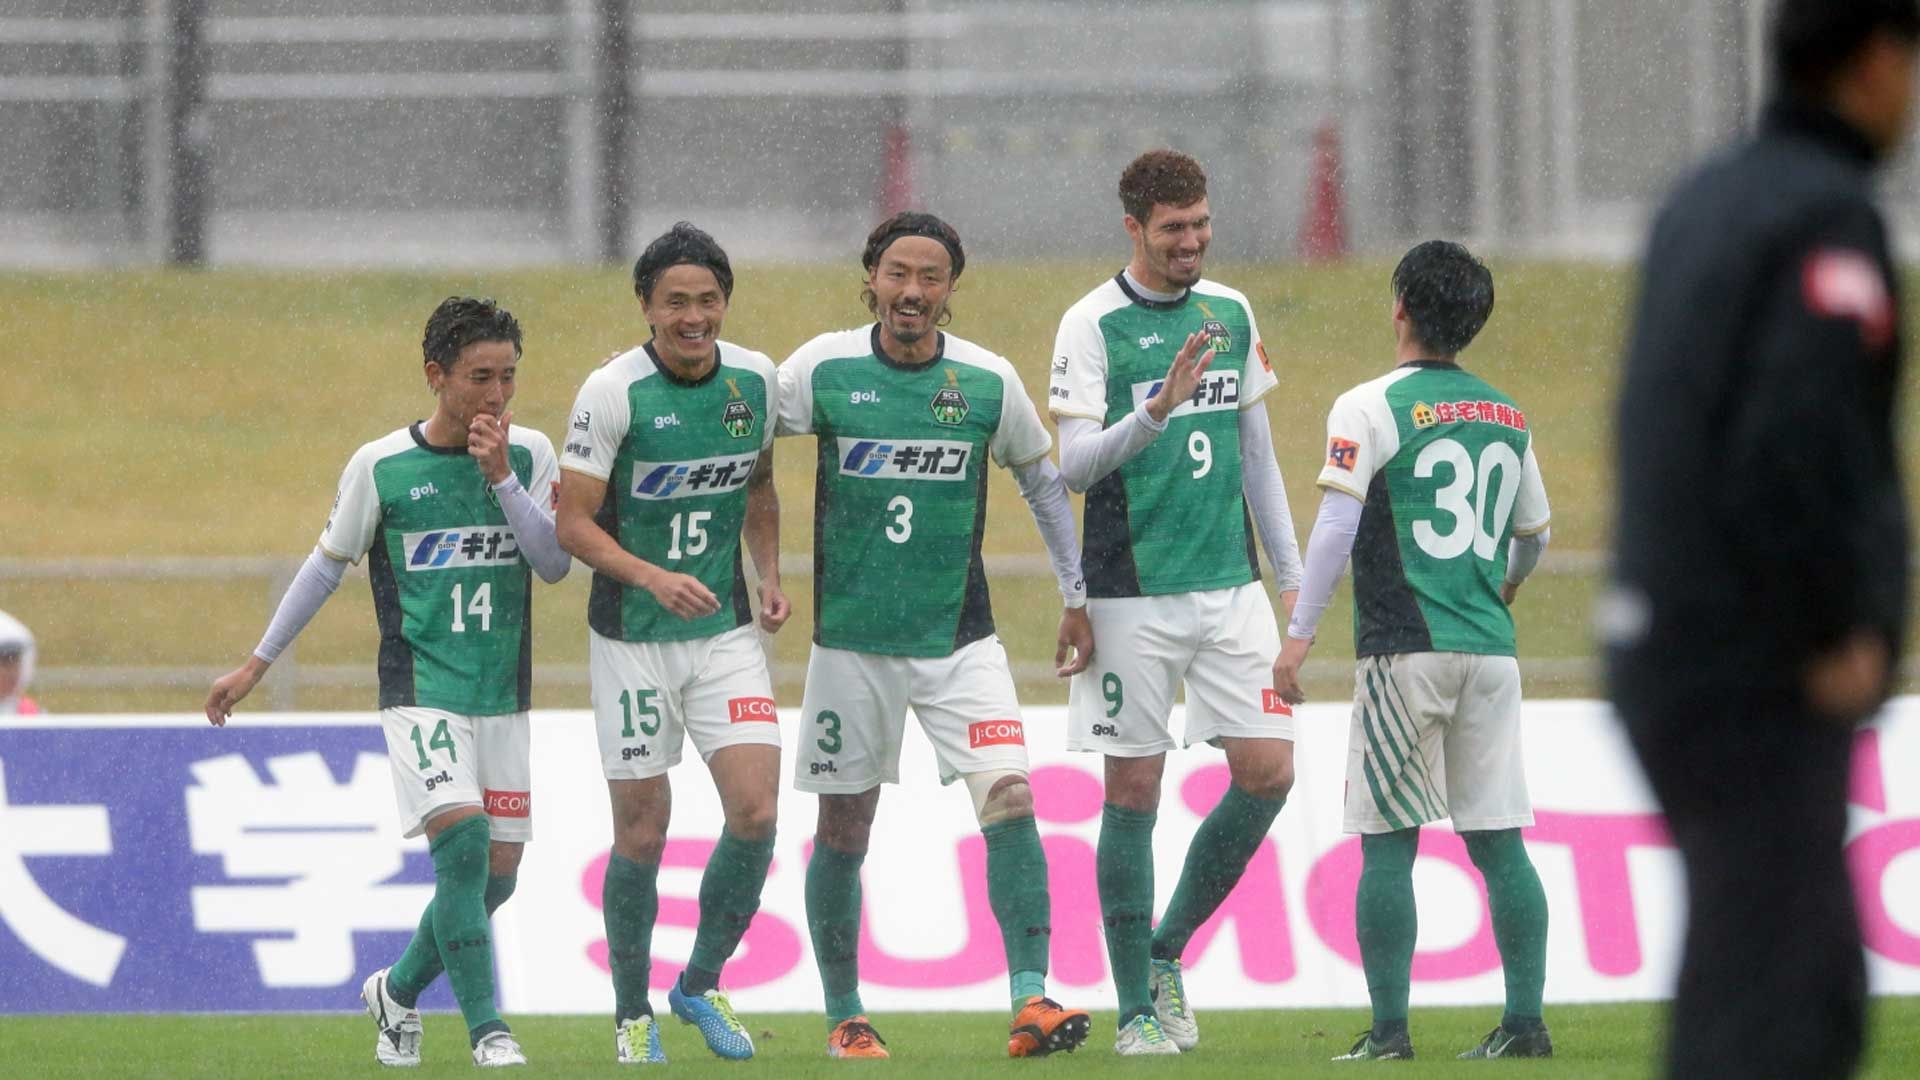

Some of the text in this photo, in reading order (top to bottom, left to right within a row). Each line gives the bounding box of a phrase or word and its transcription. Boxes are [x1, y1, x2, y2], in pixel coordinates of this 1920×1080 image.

[1139, 332, 1164, 350] gol.
[850, 390, 880, 404] gol.
[654, 413, 680, 429] gol.
[892, 446, 968, 475] ギオン
[1188, 431, 1213, 480] 9
[687, 459, 756, 490] ギオン
[410, 481, 439, 500] gol.
[1412, 438, 1521, 561] 30
[885, 495, 914, 544] 3
[460, 531, 520, 561] ギオン
[667, 511, 712, 560] 15
[450, 582, 492, 632] 14
[1102, 672, 1123, 718] 9
[619, 689, 661, 738] 15
[410, 718, 458, 770] 14
[815, 709, 842, 755] 3
[974, 724, 1022, 744] J:COM
[1091, 723, 1119, 738] gol.
[621, 744, 650, 761] gol.
[810, 760, 838, 774] gol.
[425, 769, 453, 791] gol.
